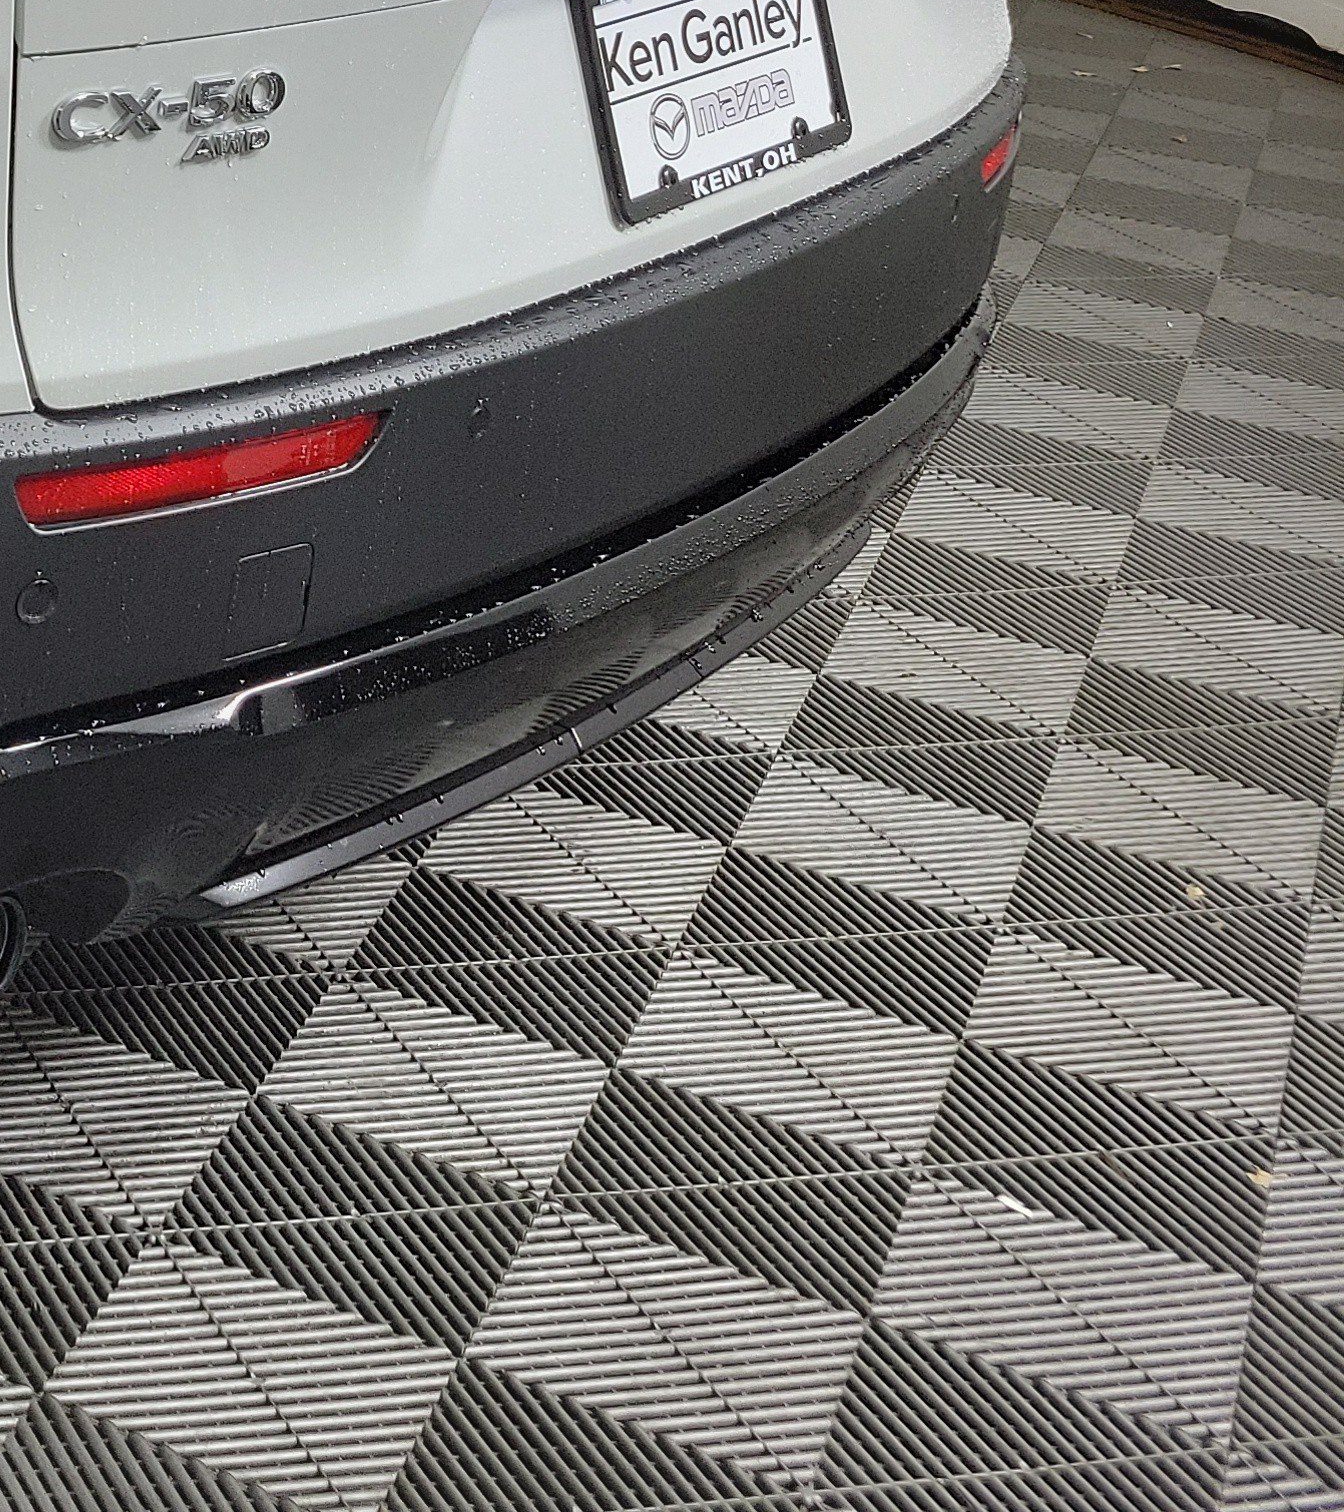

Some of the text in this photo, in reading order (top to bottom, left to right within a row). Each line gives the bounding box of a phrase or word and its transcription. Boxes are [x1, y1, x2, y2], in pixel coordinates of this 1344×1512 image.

[598, 28, 680, 94] Ken
[51, 67, 287, 144] CX-50
[690, 67, 796, 138] mazda
[179, 125, 271, 164] AWD
